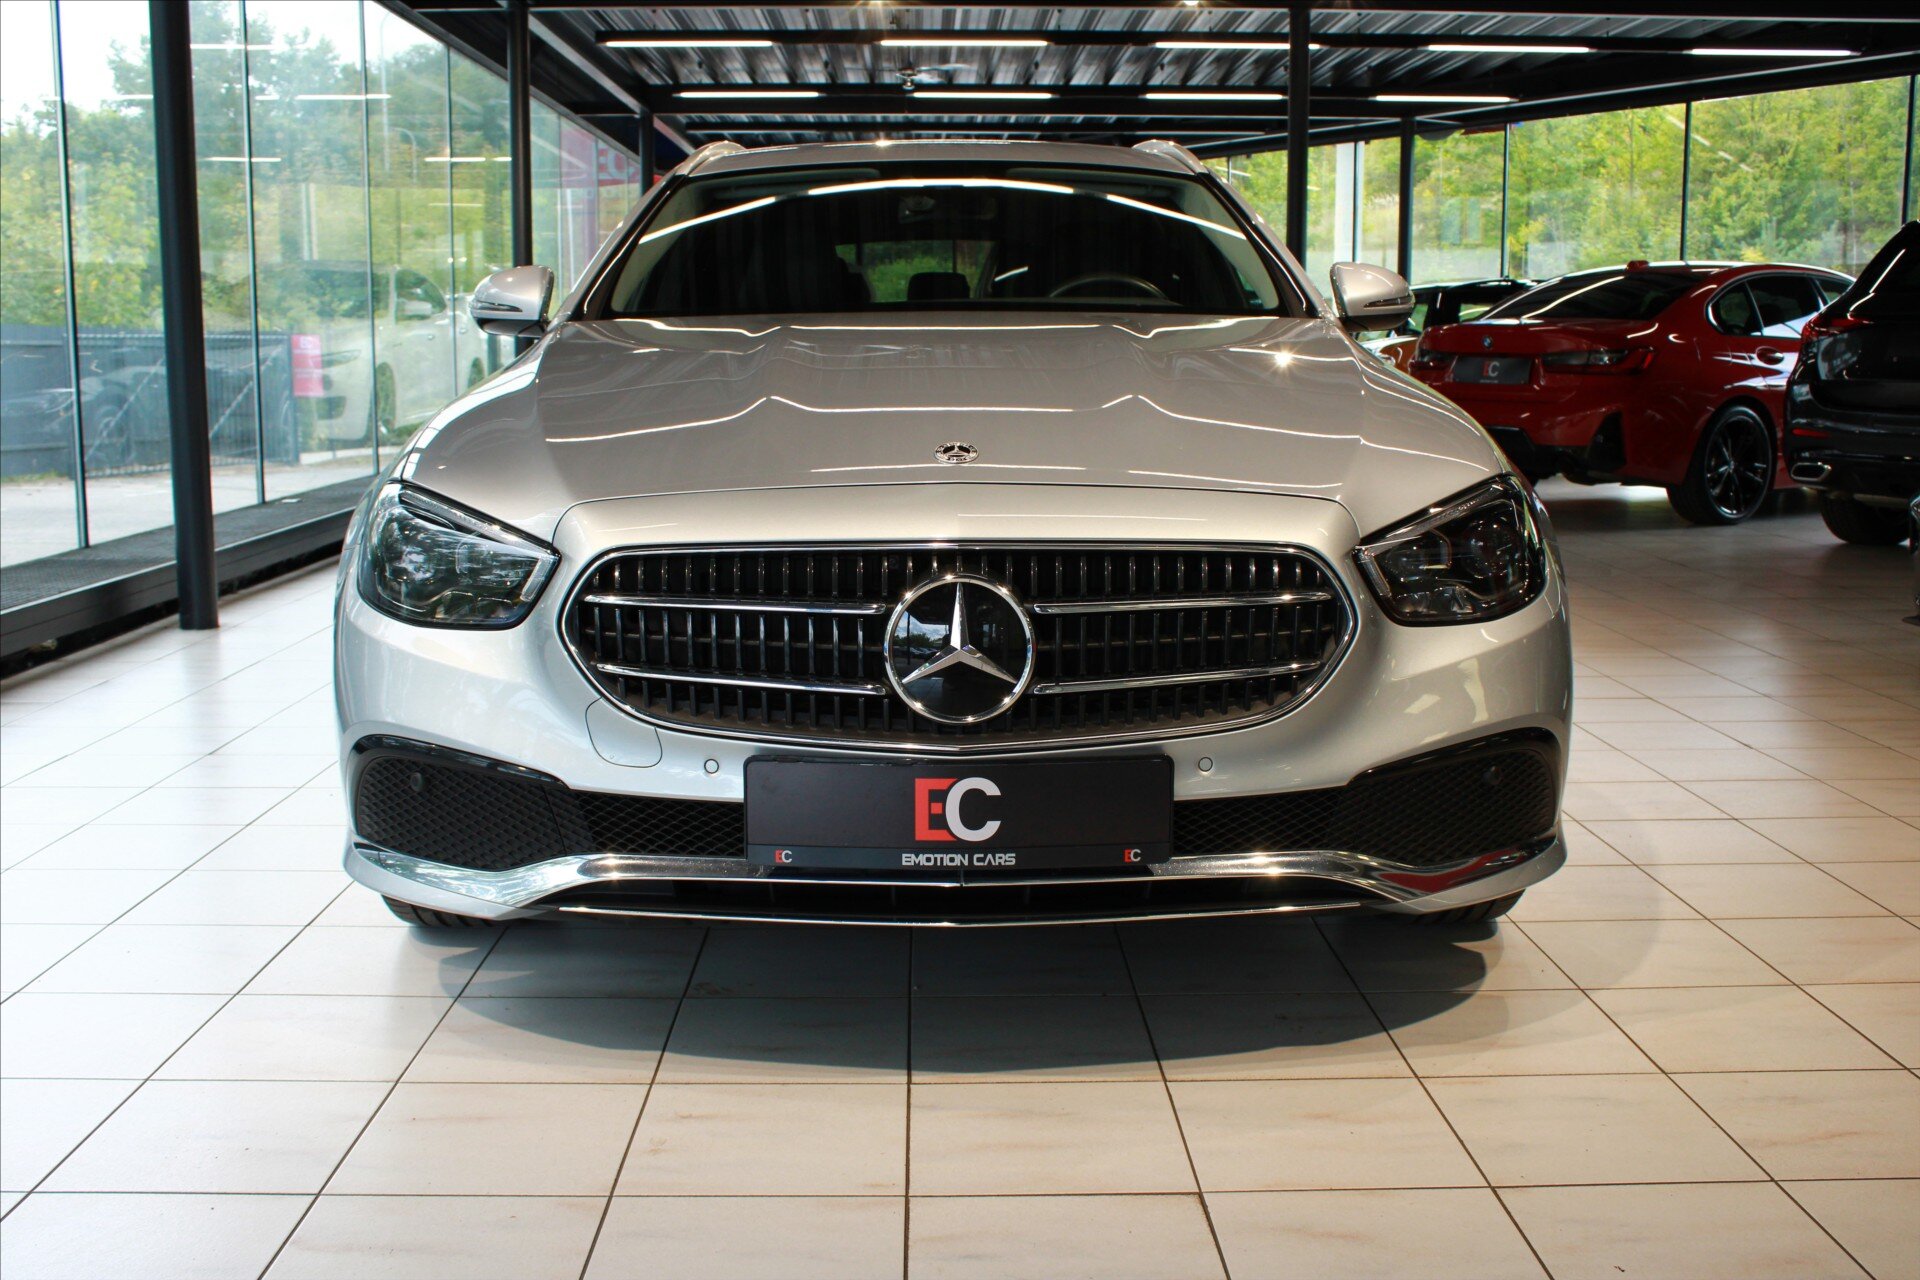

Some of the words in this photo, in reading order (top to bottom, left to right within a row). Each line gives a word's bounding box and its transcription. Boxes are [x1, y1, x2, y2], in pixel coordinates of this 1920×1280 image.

[914, 777, 1002, 842] EC
[775, 849, 793, 863] EC
[901, 853, 969, 867] EMOTION
[973, 852, 1016, 867] CARS
[1124, 848, 1142, 862] EC
